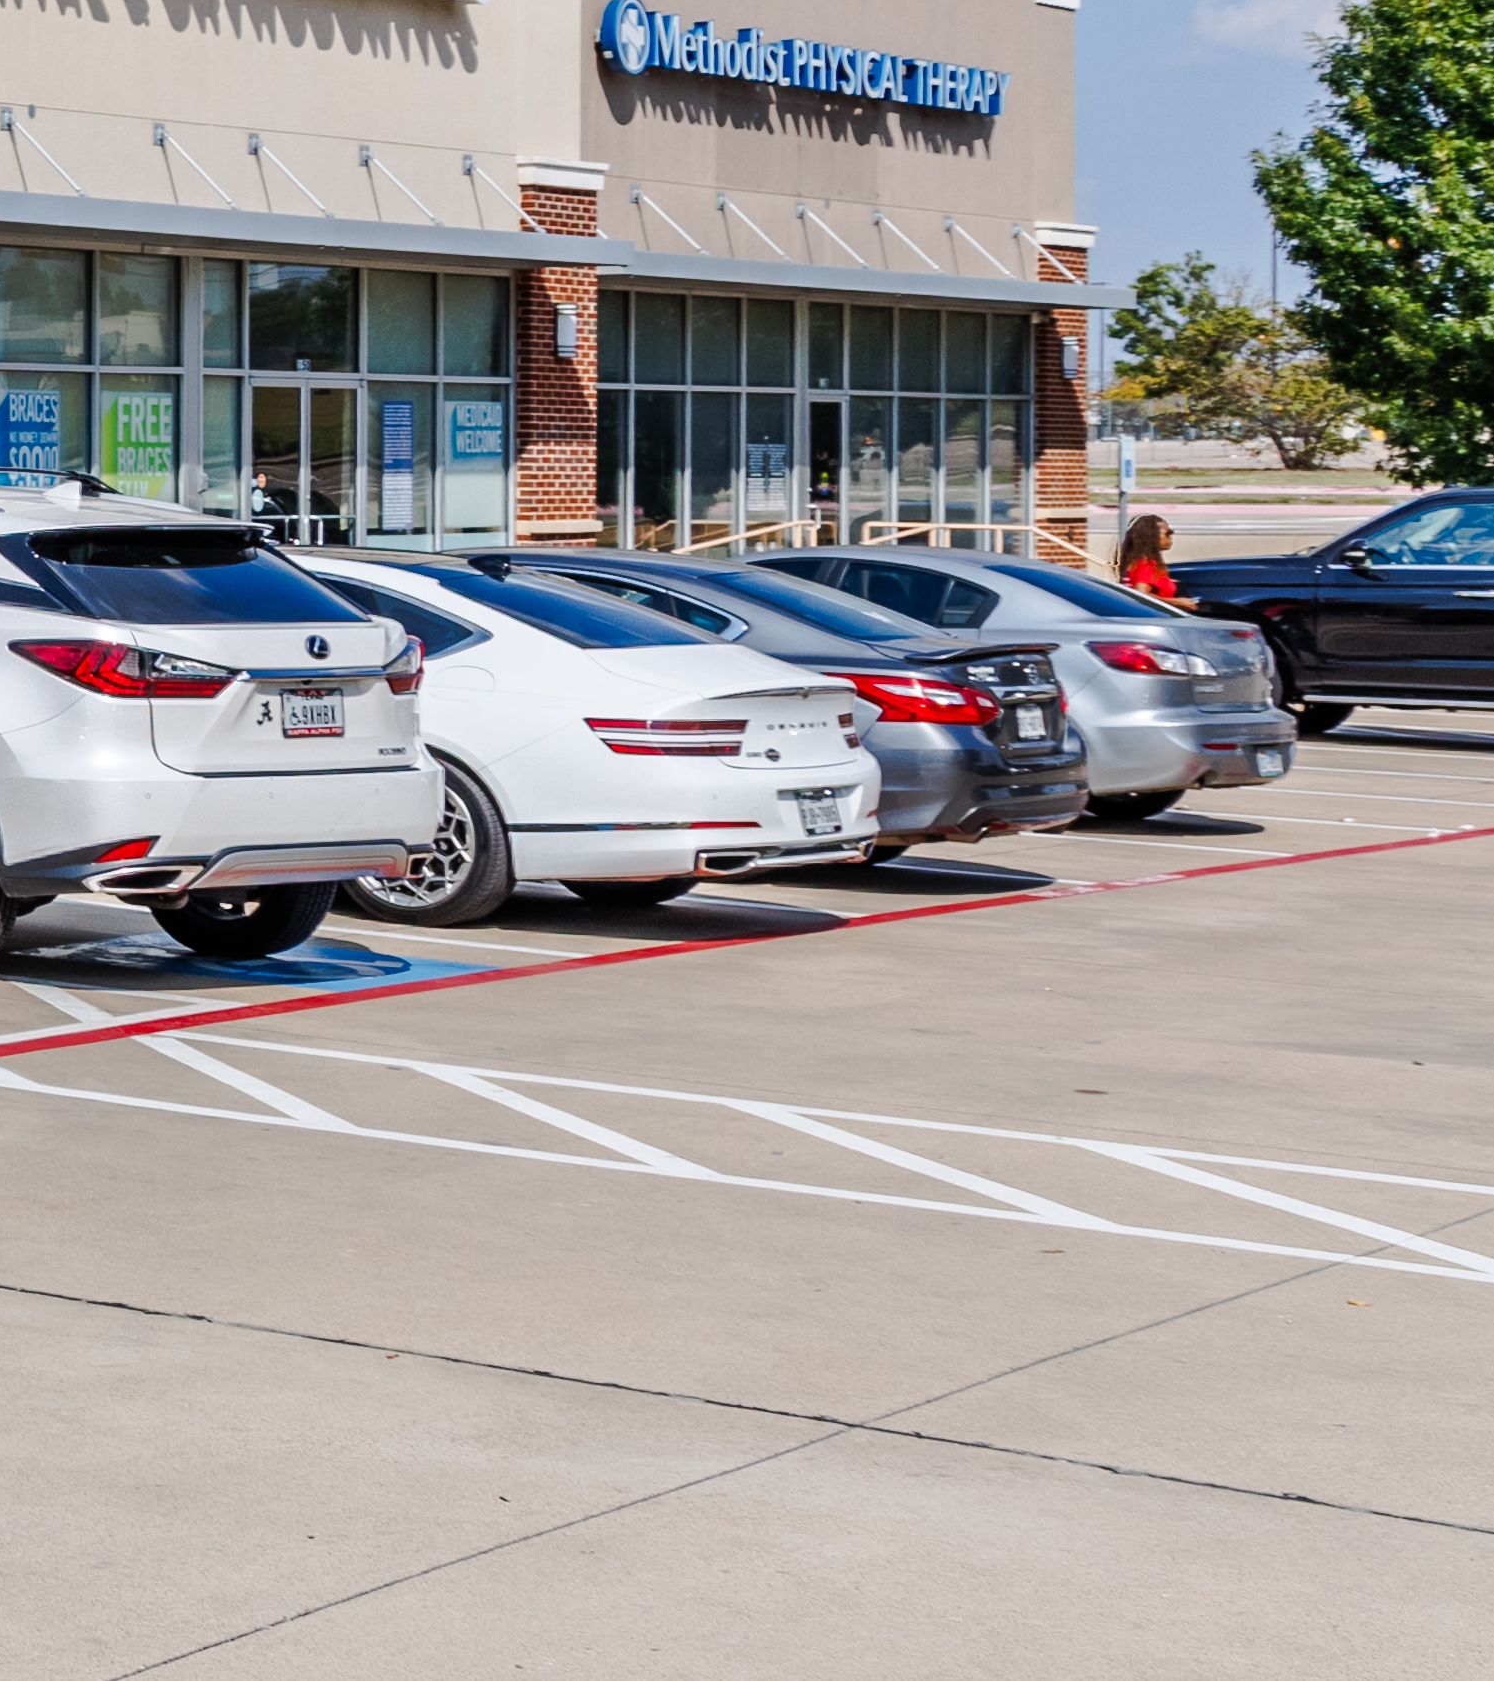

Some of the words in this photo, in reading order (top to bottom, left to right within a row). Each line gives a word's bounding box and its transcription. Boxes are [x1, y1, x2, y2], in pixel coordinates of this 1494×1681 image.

[651, 11, 792, 87] Methodist
[793, 38, 909, 103] PHYSICAL
[913, 58, 1013, 117] THERAPY
[9, 393, 59, 423] BRACES
[117, 396, 173, 443] FREE
[117, 446, 172, 476] BRACES
